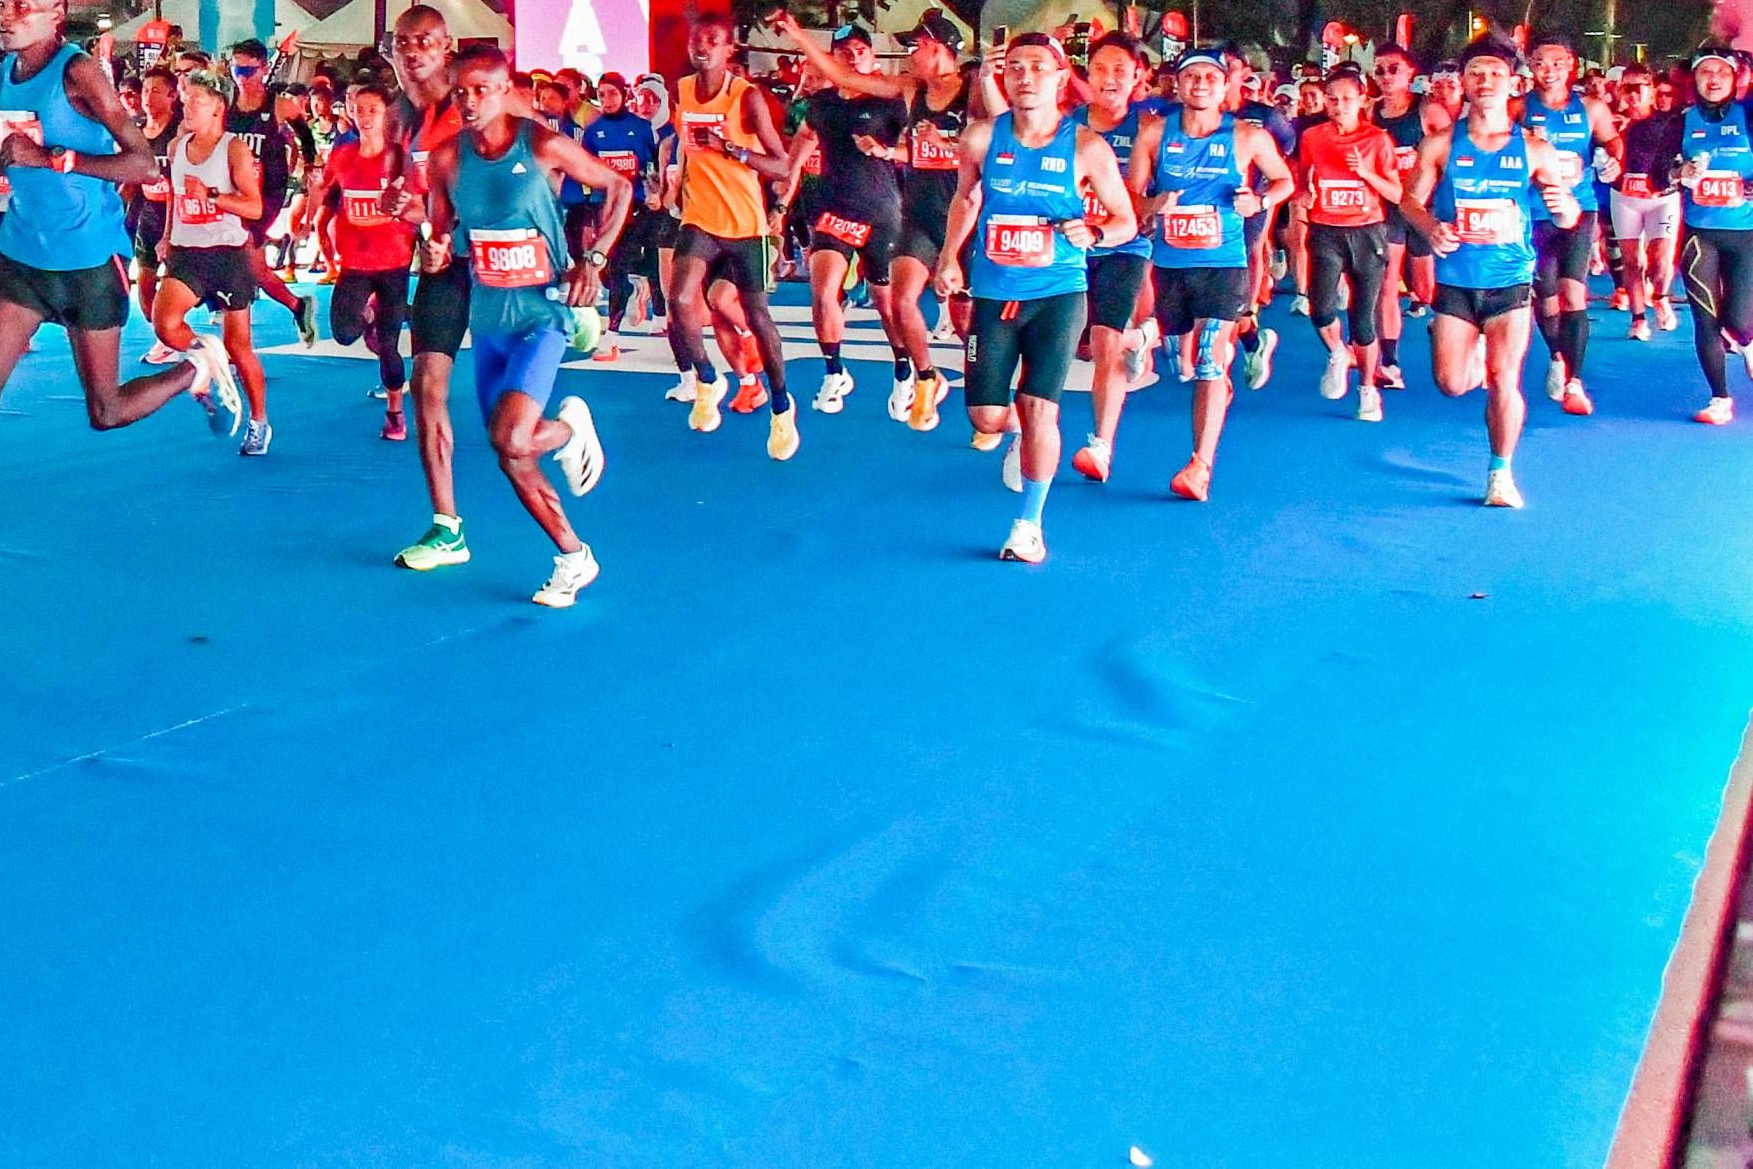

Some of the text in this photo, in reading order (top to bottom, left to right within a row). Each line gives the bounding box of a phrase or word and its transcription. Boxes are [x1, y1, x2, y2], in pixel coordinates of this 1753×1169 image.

[1500, 155, 1524, 169] AAA
[1702, 180, 1737, 197] 9413
[1330, 190, 1364, 207] 9273
[1172, 217, 1217, 237] 12453
[1000, 229, 1045, 252] 9409
[487, 244, 537, 272] 9808
